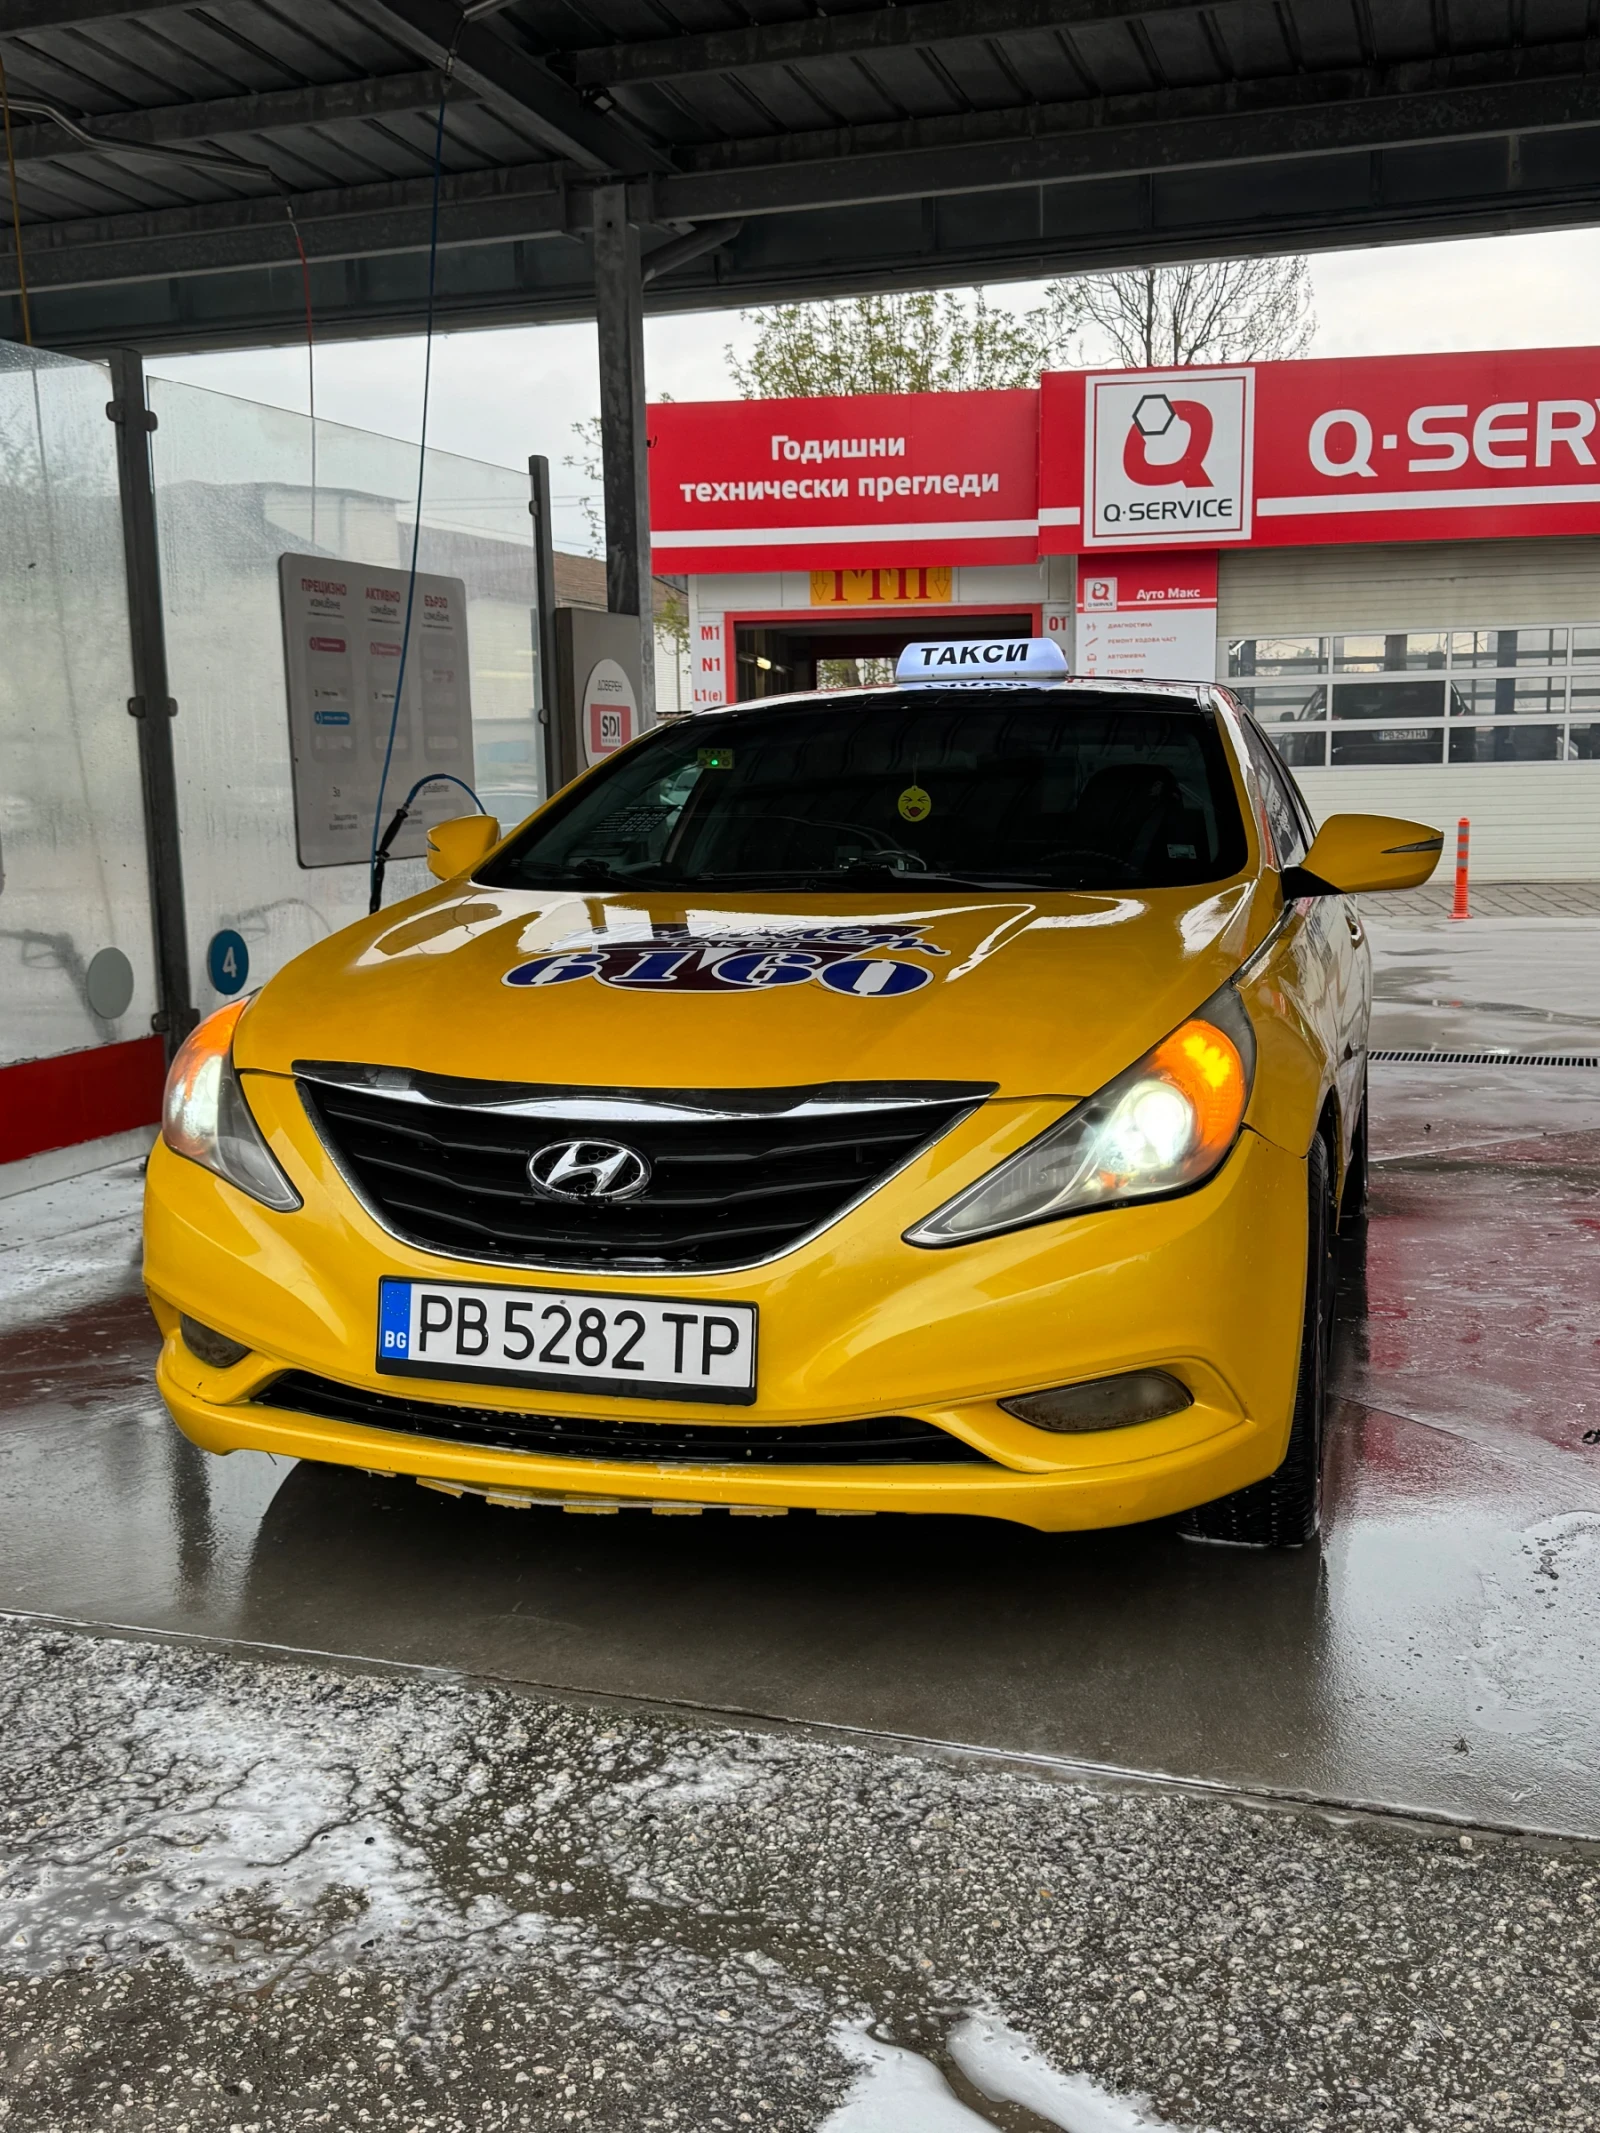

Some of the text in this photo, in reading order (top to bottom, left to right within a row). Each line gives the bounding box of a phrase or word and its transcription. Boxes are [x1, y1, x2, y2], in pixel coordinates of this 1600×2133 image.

[1308, 399, 1600, 477] Q·SER
[771, 435, 905, 464] Годишни
[680, 473, 999, 502] технически прегледи
[301, 578, 347, 596] ПРЕЦИЗНО
[365, 587, 401, 603] АКТИВНО
[1136, 587, 1200, 602] Ауто Макс
[424, 595, 448, 609] БЪРЗО
[701, 626, 719, 641] M1
[1107, 622, 1152, 630] ДИАГНОСТИКА
[921, 643, 1029, 666] ТАКСИ
[702, 657, 720, 672] N1
[694, 689, 722, 702] L1(e)
[602, 715, 620, 737] SDI
[667, 941, 801, 949] ТАКСИ
[222, 946, 237, 978] 4
[501, 949, 934, 998] 6160
[384, 1330, 407, 1350] BG
[419, 1294, 739, 1376] PB 5282 TP
